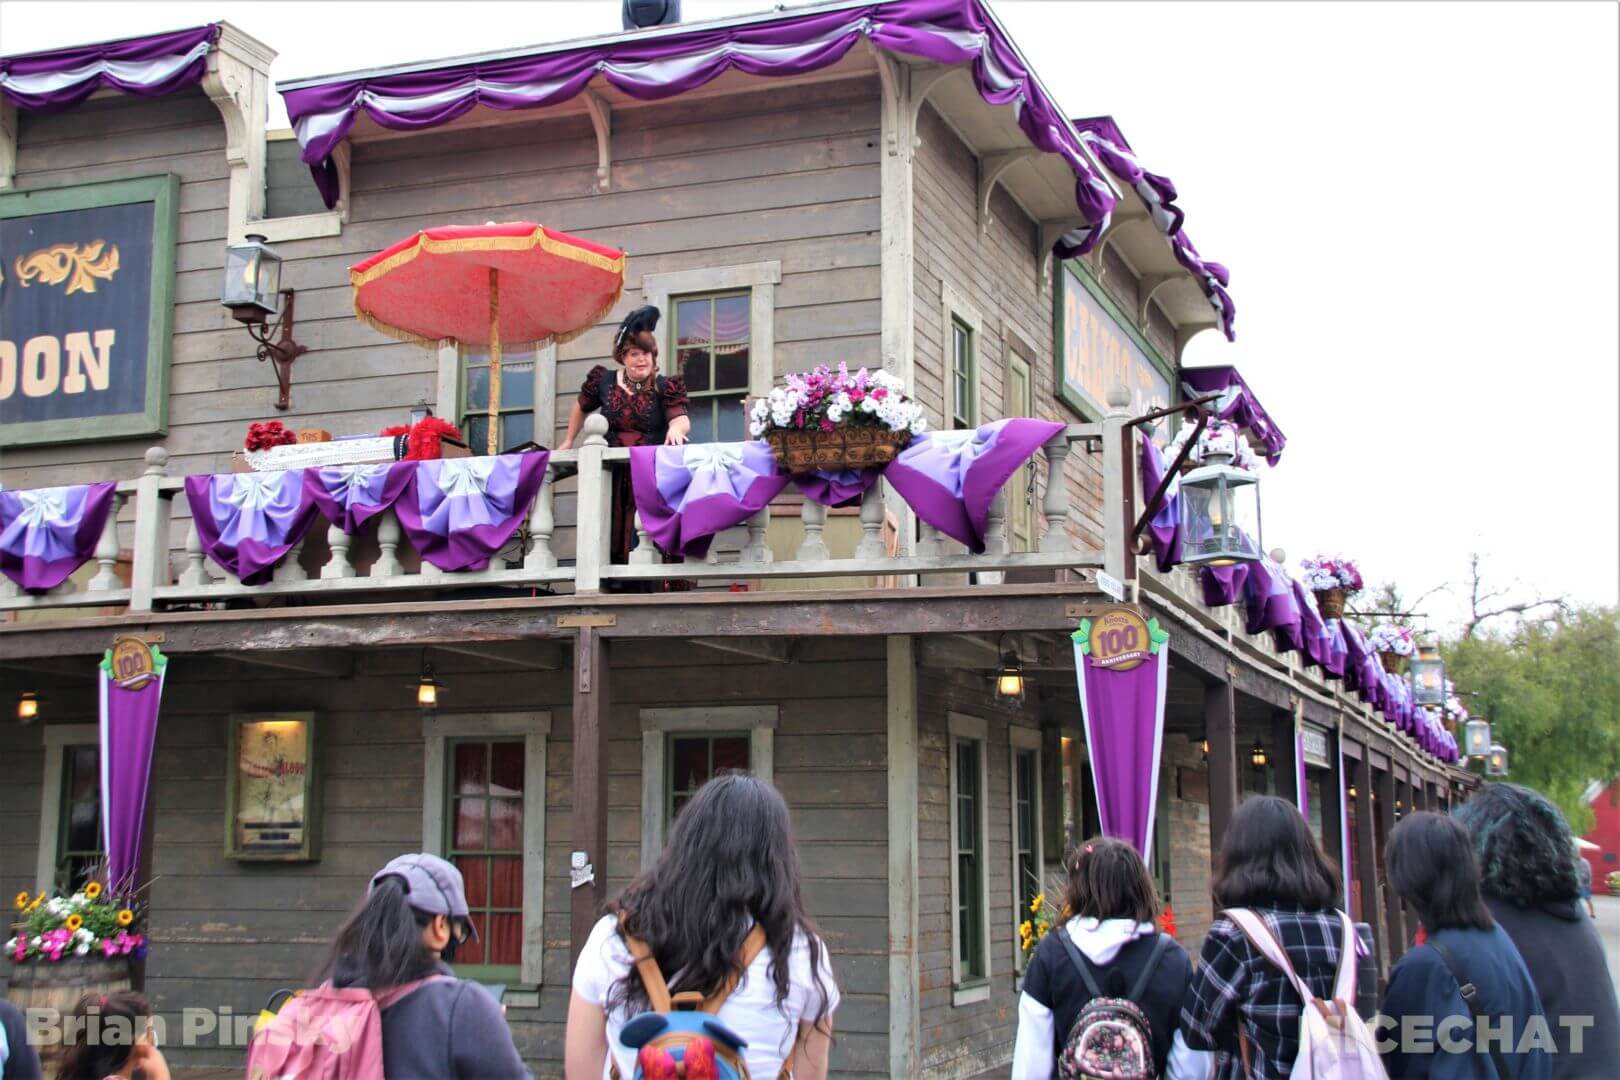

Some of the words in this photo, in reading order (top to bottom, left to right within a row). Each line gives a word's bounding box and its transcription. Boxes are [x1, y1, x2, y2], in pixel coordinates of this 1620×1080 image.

[1098, 625, 1137, 656] 100
[118, 652, 144, 679] 100
[1101, 651, 1141, 665] ANNIVERSARY
